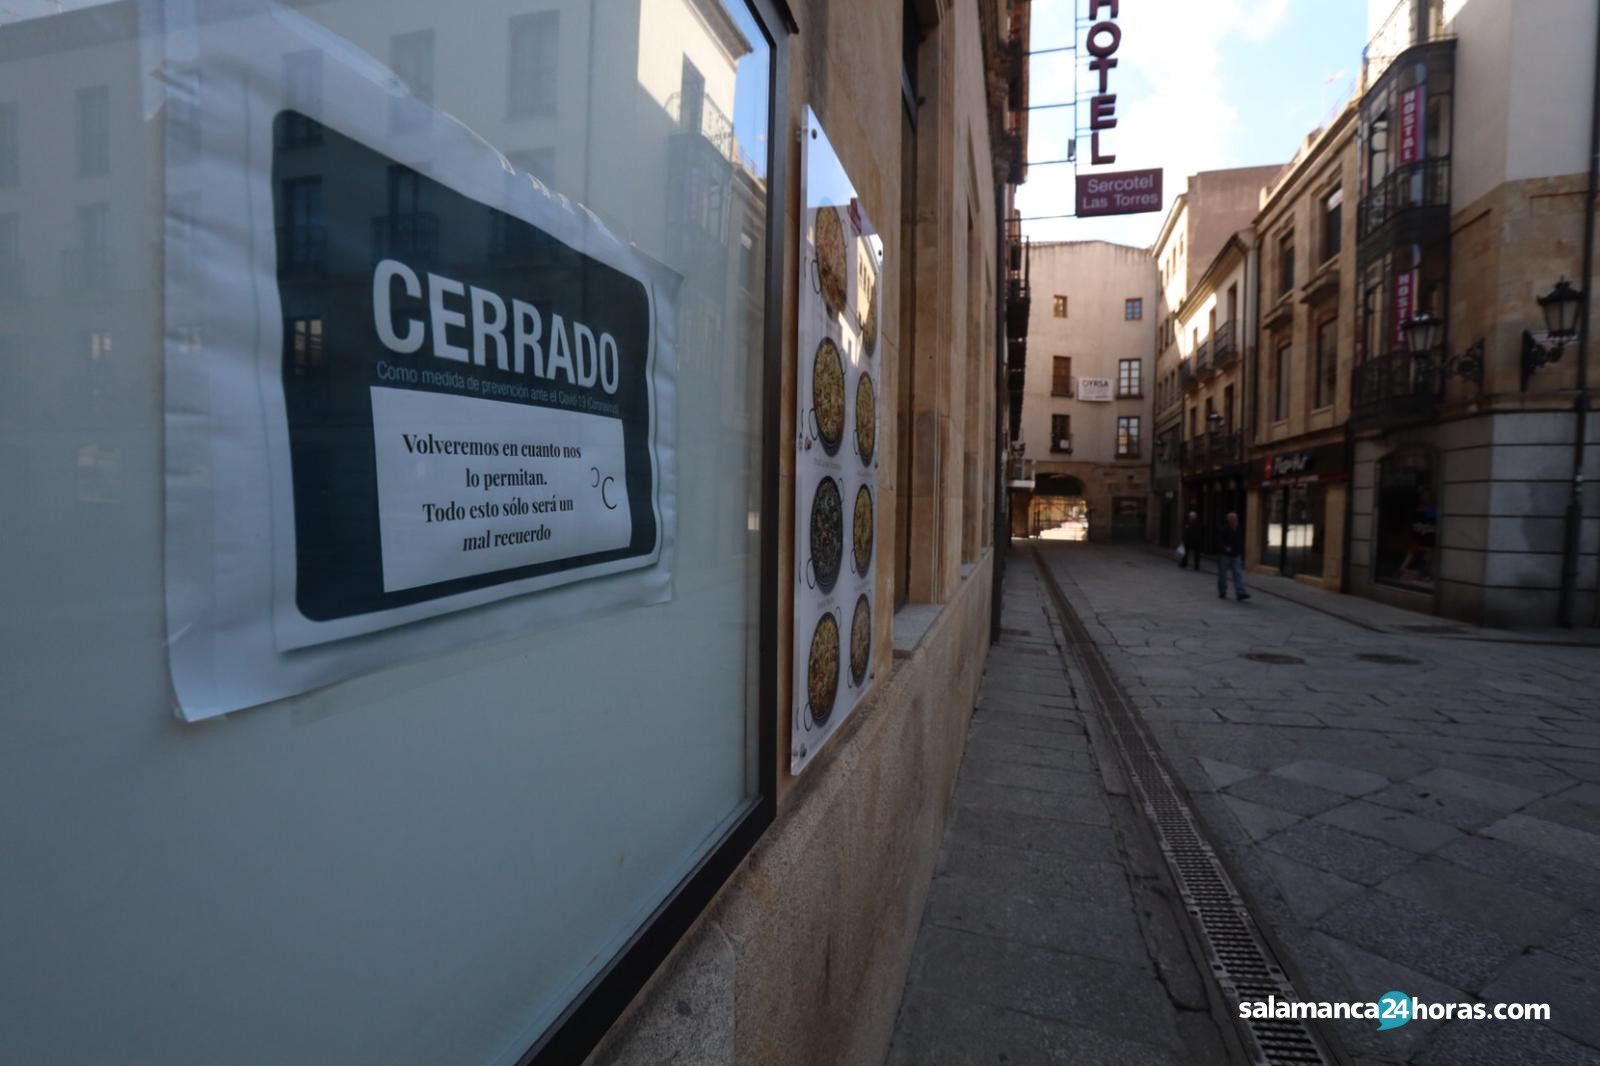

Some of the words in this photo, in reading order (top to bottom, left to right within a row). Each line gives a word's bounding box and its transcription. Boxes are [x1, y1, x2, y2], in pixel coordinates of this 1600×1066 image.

[1403, 90, 1416, 159] HOSTAL
[1088, 175, 1153, 193] Sercotel
[1083, 197, 1108, 209] Las
[1113, 193, 1158, 206] Torres
[372, 258, 619, 395] CERRADO
[376, 361, 418, 383] Como
[421, 369, 465, 389] medida
[466, 375, 480, 391] de
[481, 379, 529, 400] prevención
[530, 387, 548, 402] ante
[549, 389, 557, 402] el
[402, 433, 499, 456] Volveremos
[503, 442, 519, 456] en
[521, 443, 561, 458] cuanto
[563, 448, 582, 459] nos
[466, 468, 480, 487] lo
[484, 468, 548, 490] permitan.
[422, 501, 466, 523] Todo
[469, 502, 500, 519] esto
[503, 496, 529, 517] sólo
[532, 494, 557, 513] será
[559, 499, 574, 512] un
[463, 530, 491, 551] mal
[494, 524, 552, 547] recuerdo
